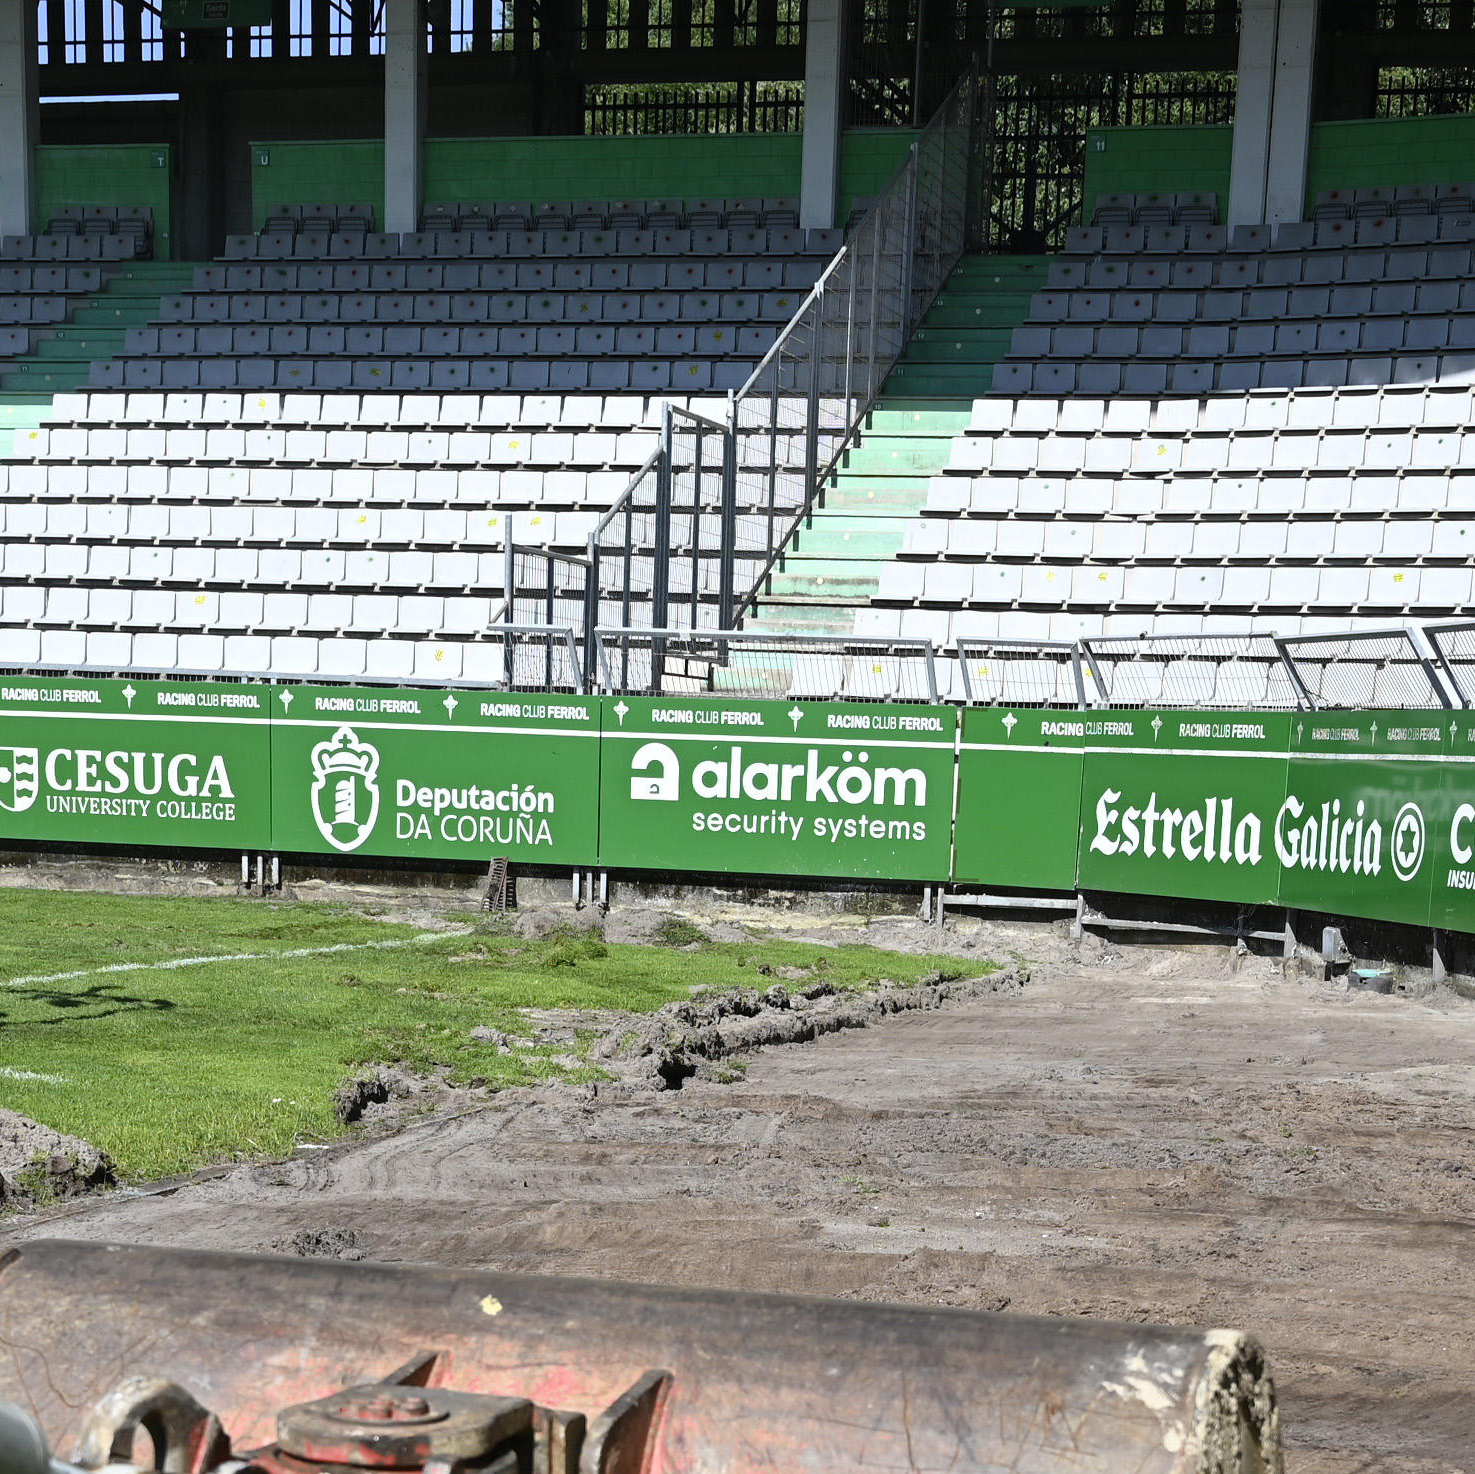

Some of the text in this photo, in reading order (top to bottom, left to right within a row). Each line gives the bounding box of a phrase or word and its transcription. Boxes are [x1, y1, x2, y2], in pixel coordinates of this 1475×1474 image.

[1095, 140, 1105, 152] 11
[157, 157, 165, 167] T
[261, 155, 269, 166] U
[1, 687, 101, 704] RACING CLUB FERROL
[158, 692, 261, 708] RACING CLUB FERROL
[315, 697, 421, 714] RACING CLUB FERROL
[481, 703, 589, 720] RACING CLUB FERROL
[651, 709, 764, 726] RACING CLUB FERROL
[827, 714, 943, 732] RACING CLUB FERROL
[1041, 721, 1134, 736] RACING CLUB FERROL
[1179, 722, 1265, 739] RACING CLUB FERROL
[45, 748, 236, 798] CESUGA
[691, 746, 927, 808] alarköm
[396, 779, 555, 816] Deputación
[47, 795, 236, 822] UNIVERSITY COLLEGE
[396, 812, 553, 846] DA CORUÑA
[692, 809, 926, 844] security systems
[1090, 787, 1263, 866] Estrella
[1273, 794, 1382, 877] Galicia
